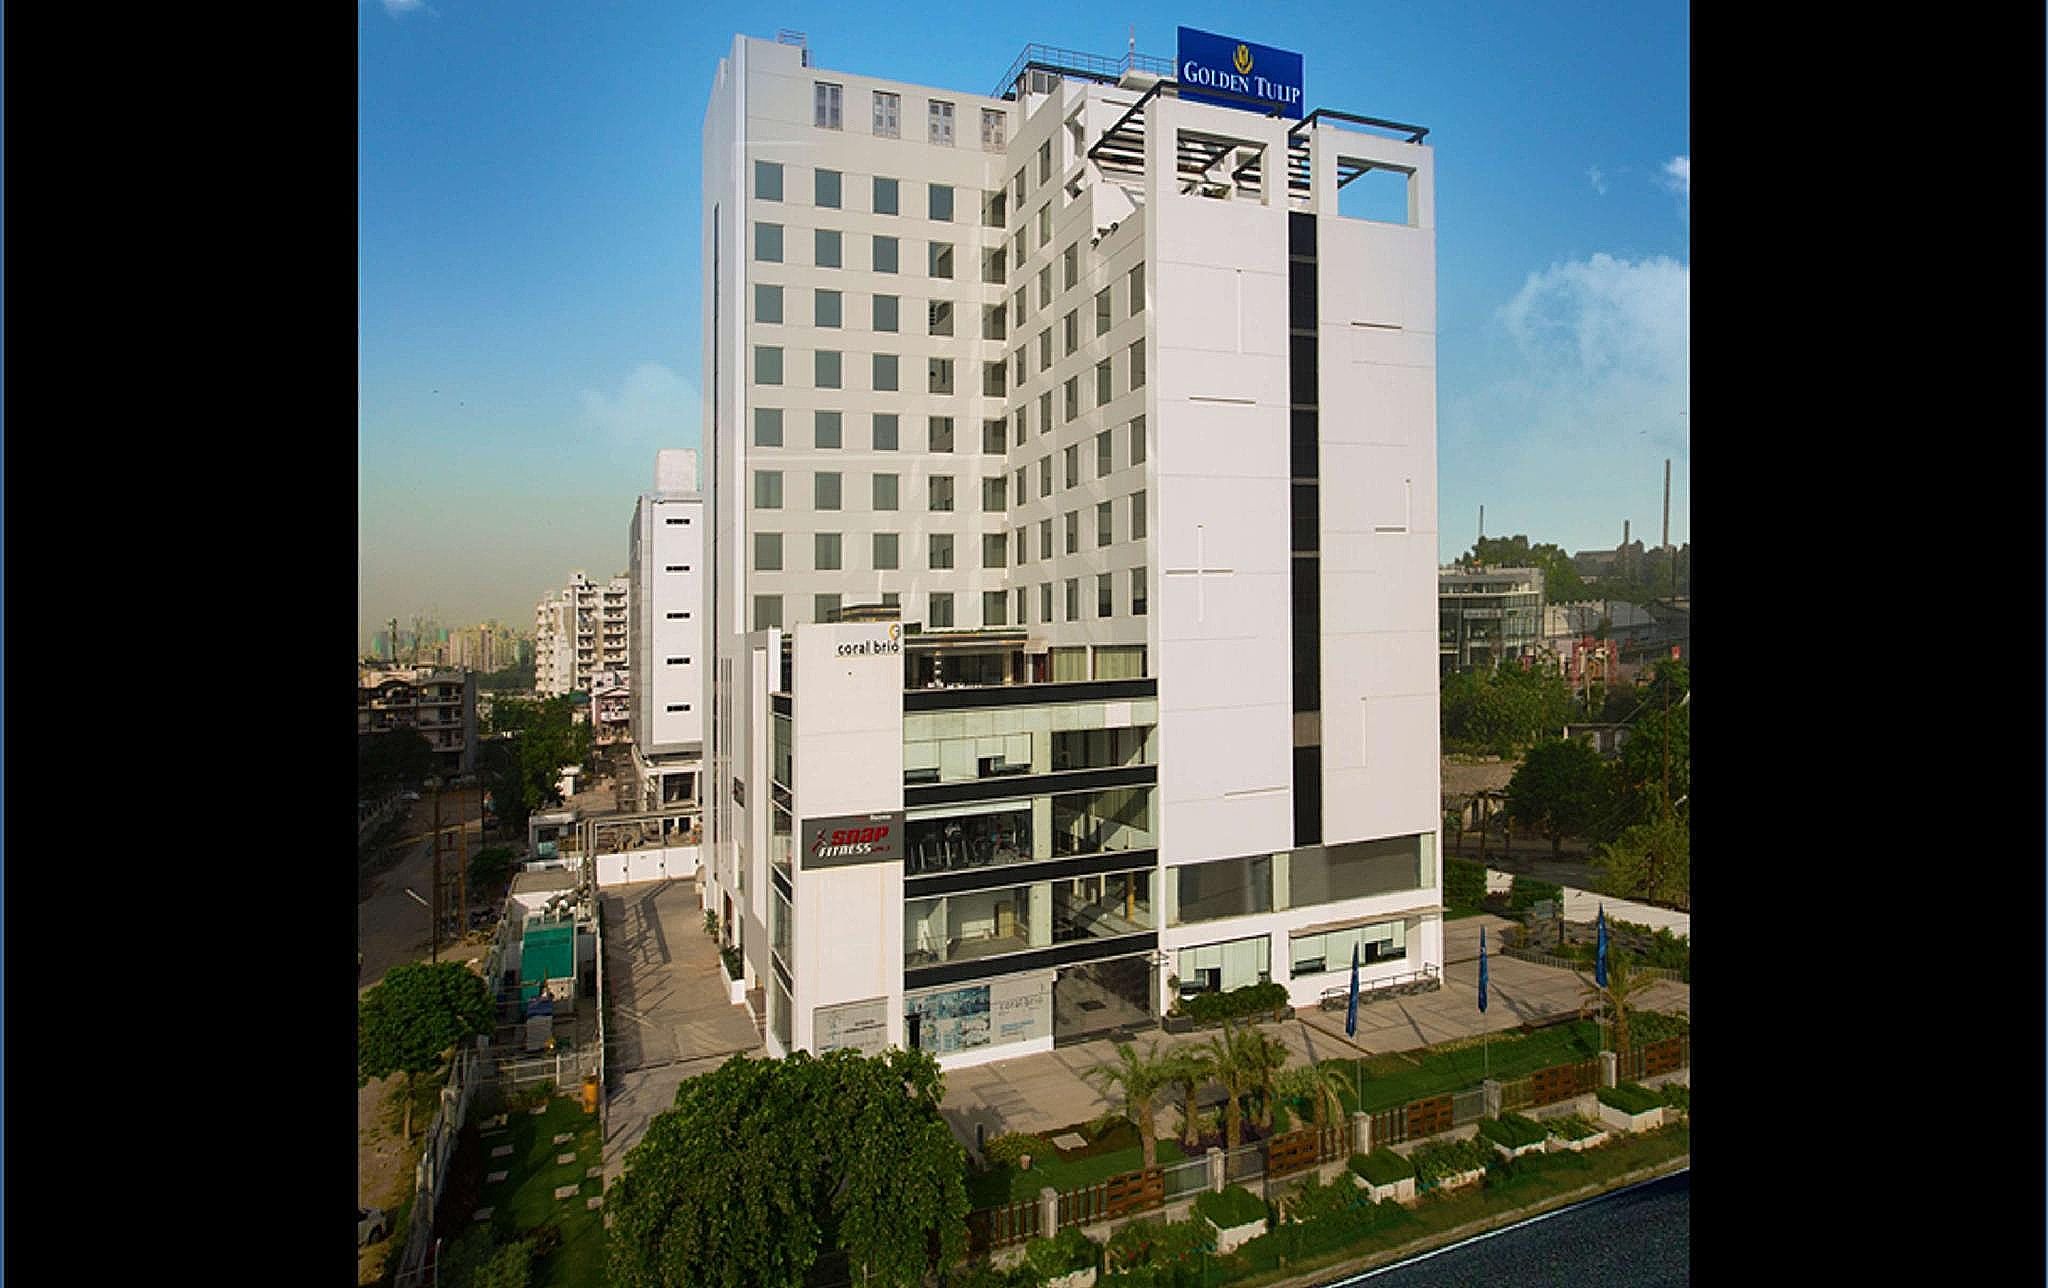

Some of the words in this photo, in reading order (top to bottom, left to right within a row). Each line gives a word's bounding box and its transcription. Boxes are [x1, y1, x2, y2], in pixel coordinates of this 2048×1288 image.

[1183, 60, 1249, 93] GOLDEN
[1254, 75, 1301, 104] TULIP
[838, 640, 871, 656] coral
[873, 640, 900, 655] brio
